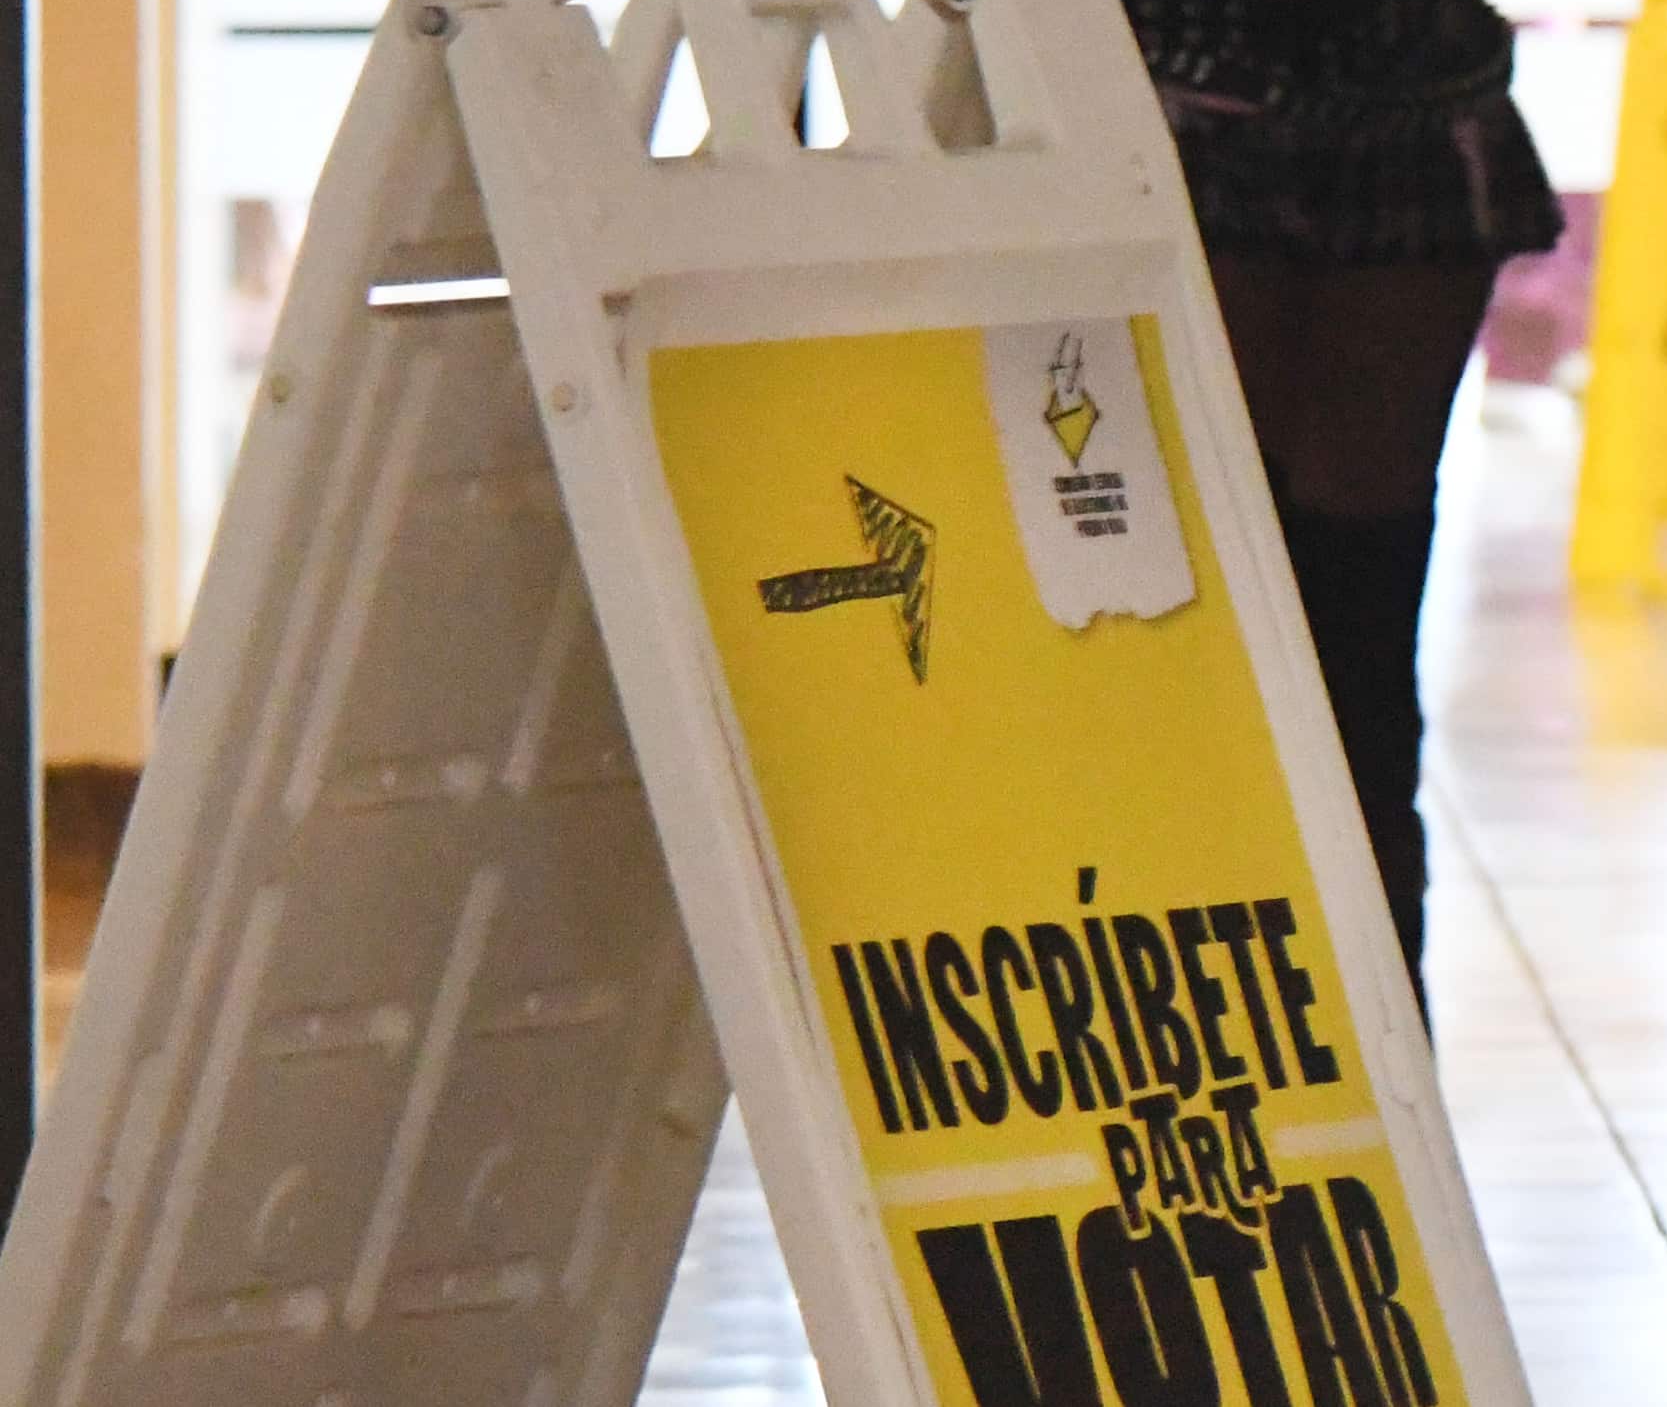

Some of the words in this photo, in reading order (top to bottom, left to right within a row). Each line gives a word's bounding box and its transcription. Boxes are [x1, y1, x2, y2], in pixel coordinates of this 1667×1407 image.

[831, 866, 1341, 1134] INSCRÍBETE
[1101, 1082, 1276, 1230] PARA
[915, 1176, 1438, 1407] VOTAR
